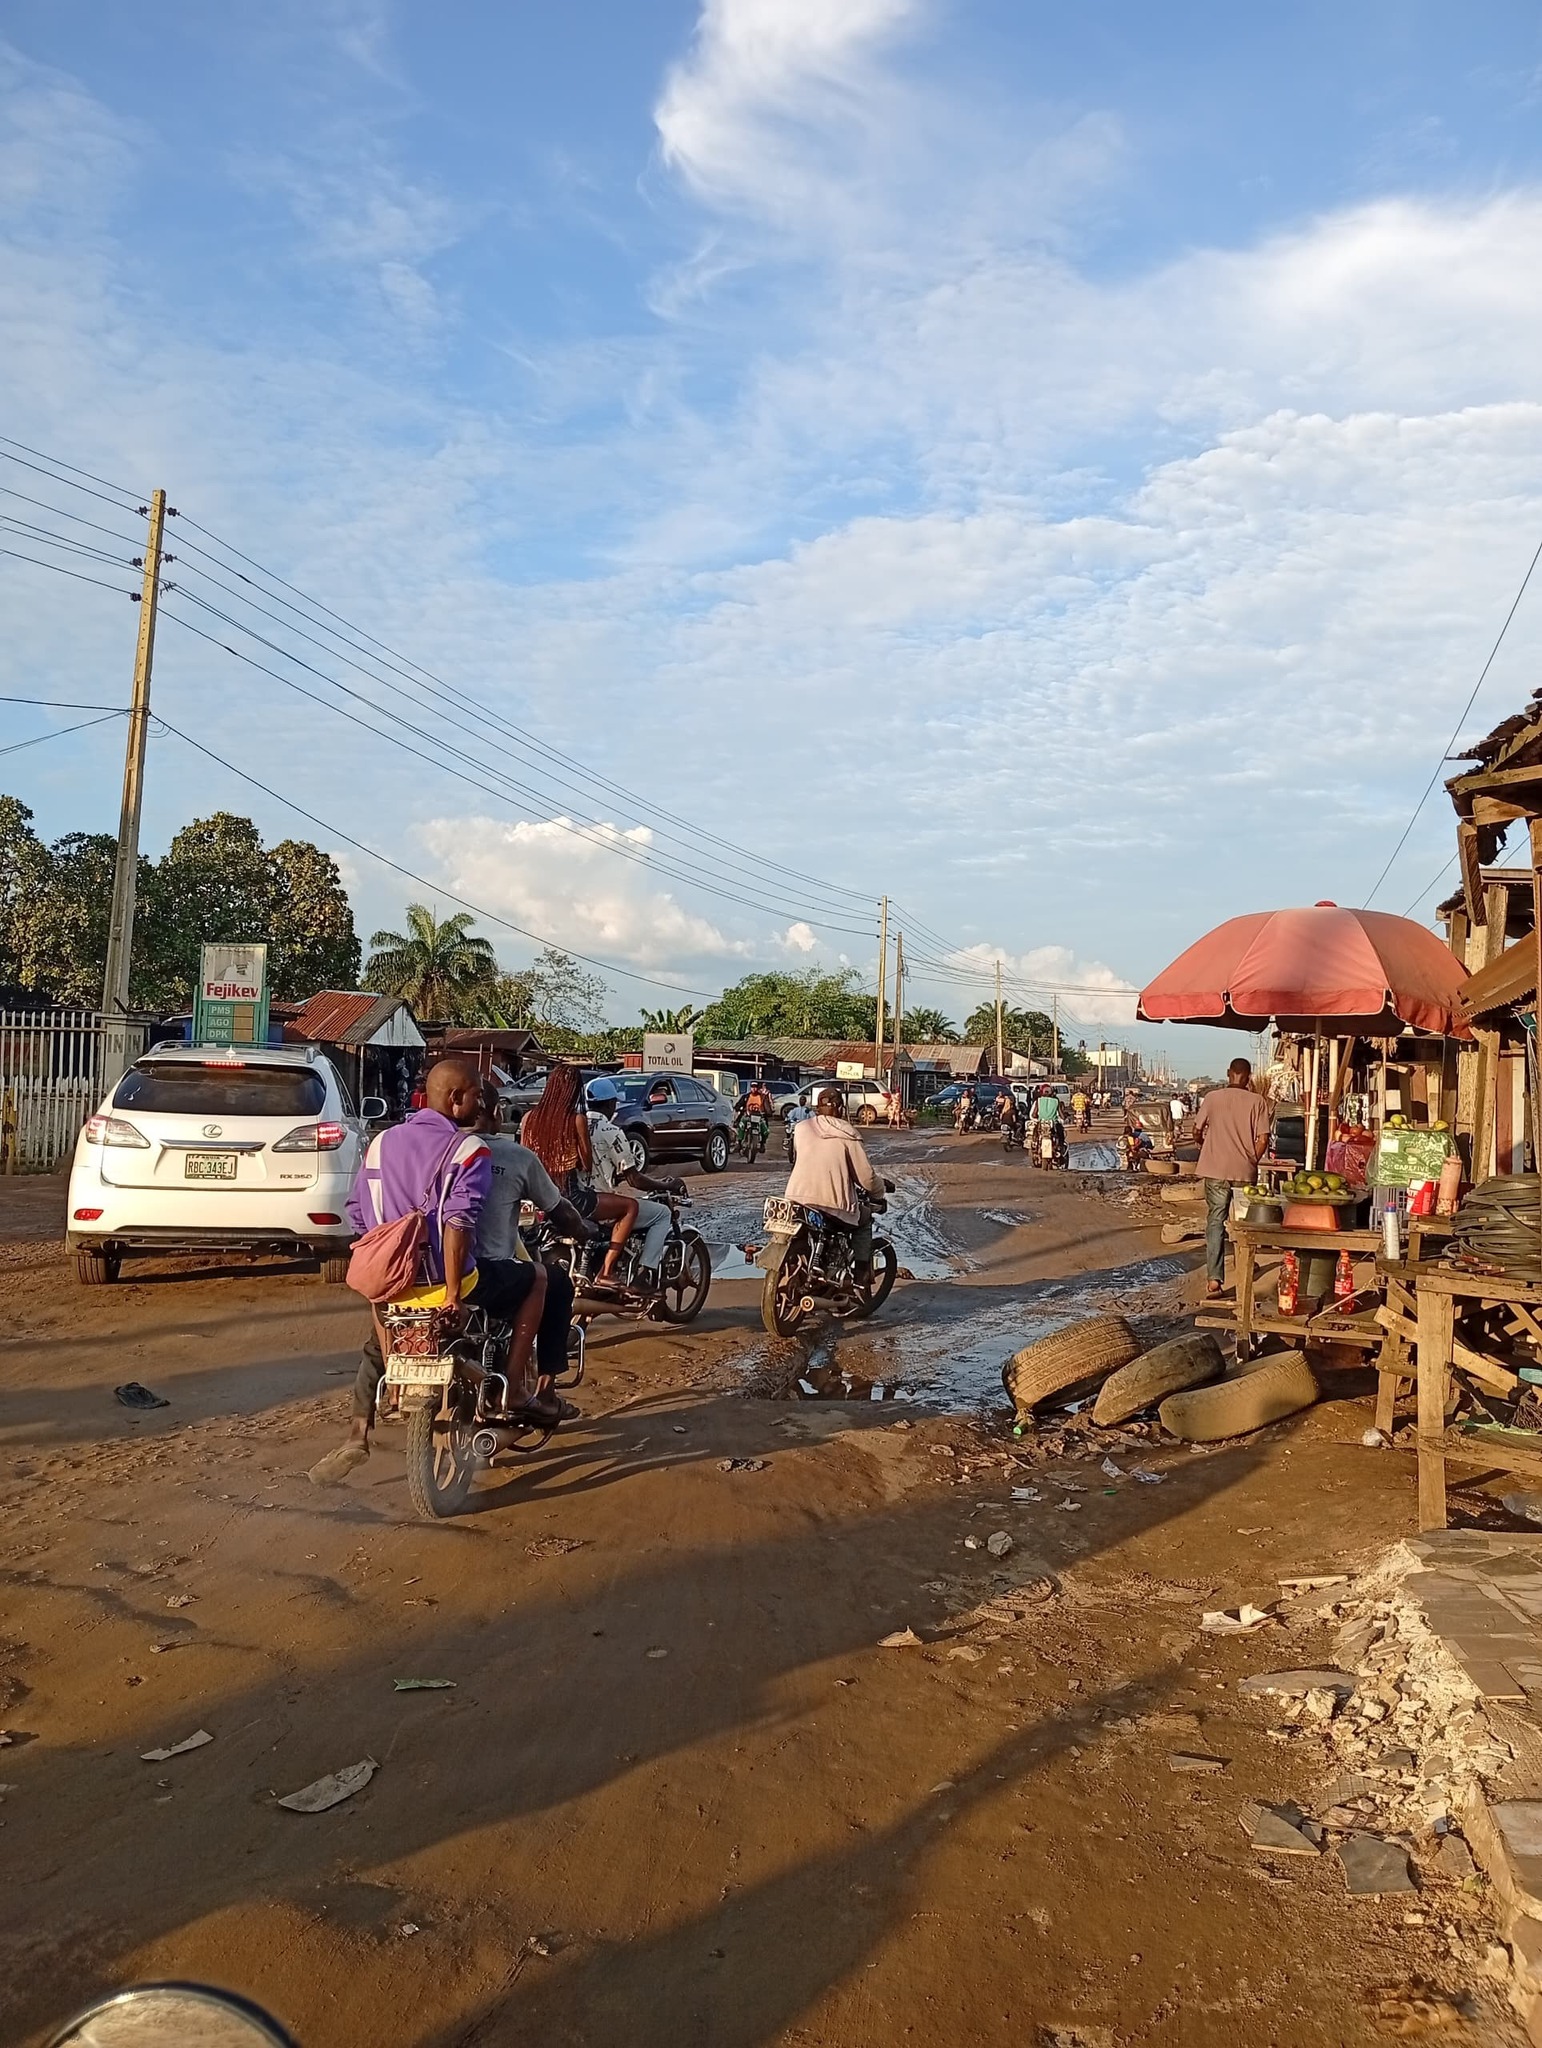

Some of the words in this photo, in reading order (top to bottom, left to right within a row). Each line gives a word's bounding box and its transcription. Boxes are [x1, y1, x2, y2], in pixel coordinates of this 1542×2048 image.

[206, 982, 259, 999] Fejikev
[211, 1006, 231, 1015] PMS
[209, 1018, 230, 1027] AGO
[209, 1030, 229, 1038] DPK
[647, 1055, 670, 1066] TOTAL
[671, 1056, 684, 1067] OIL
